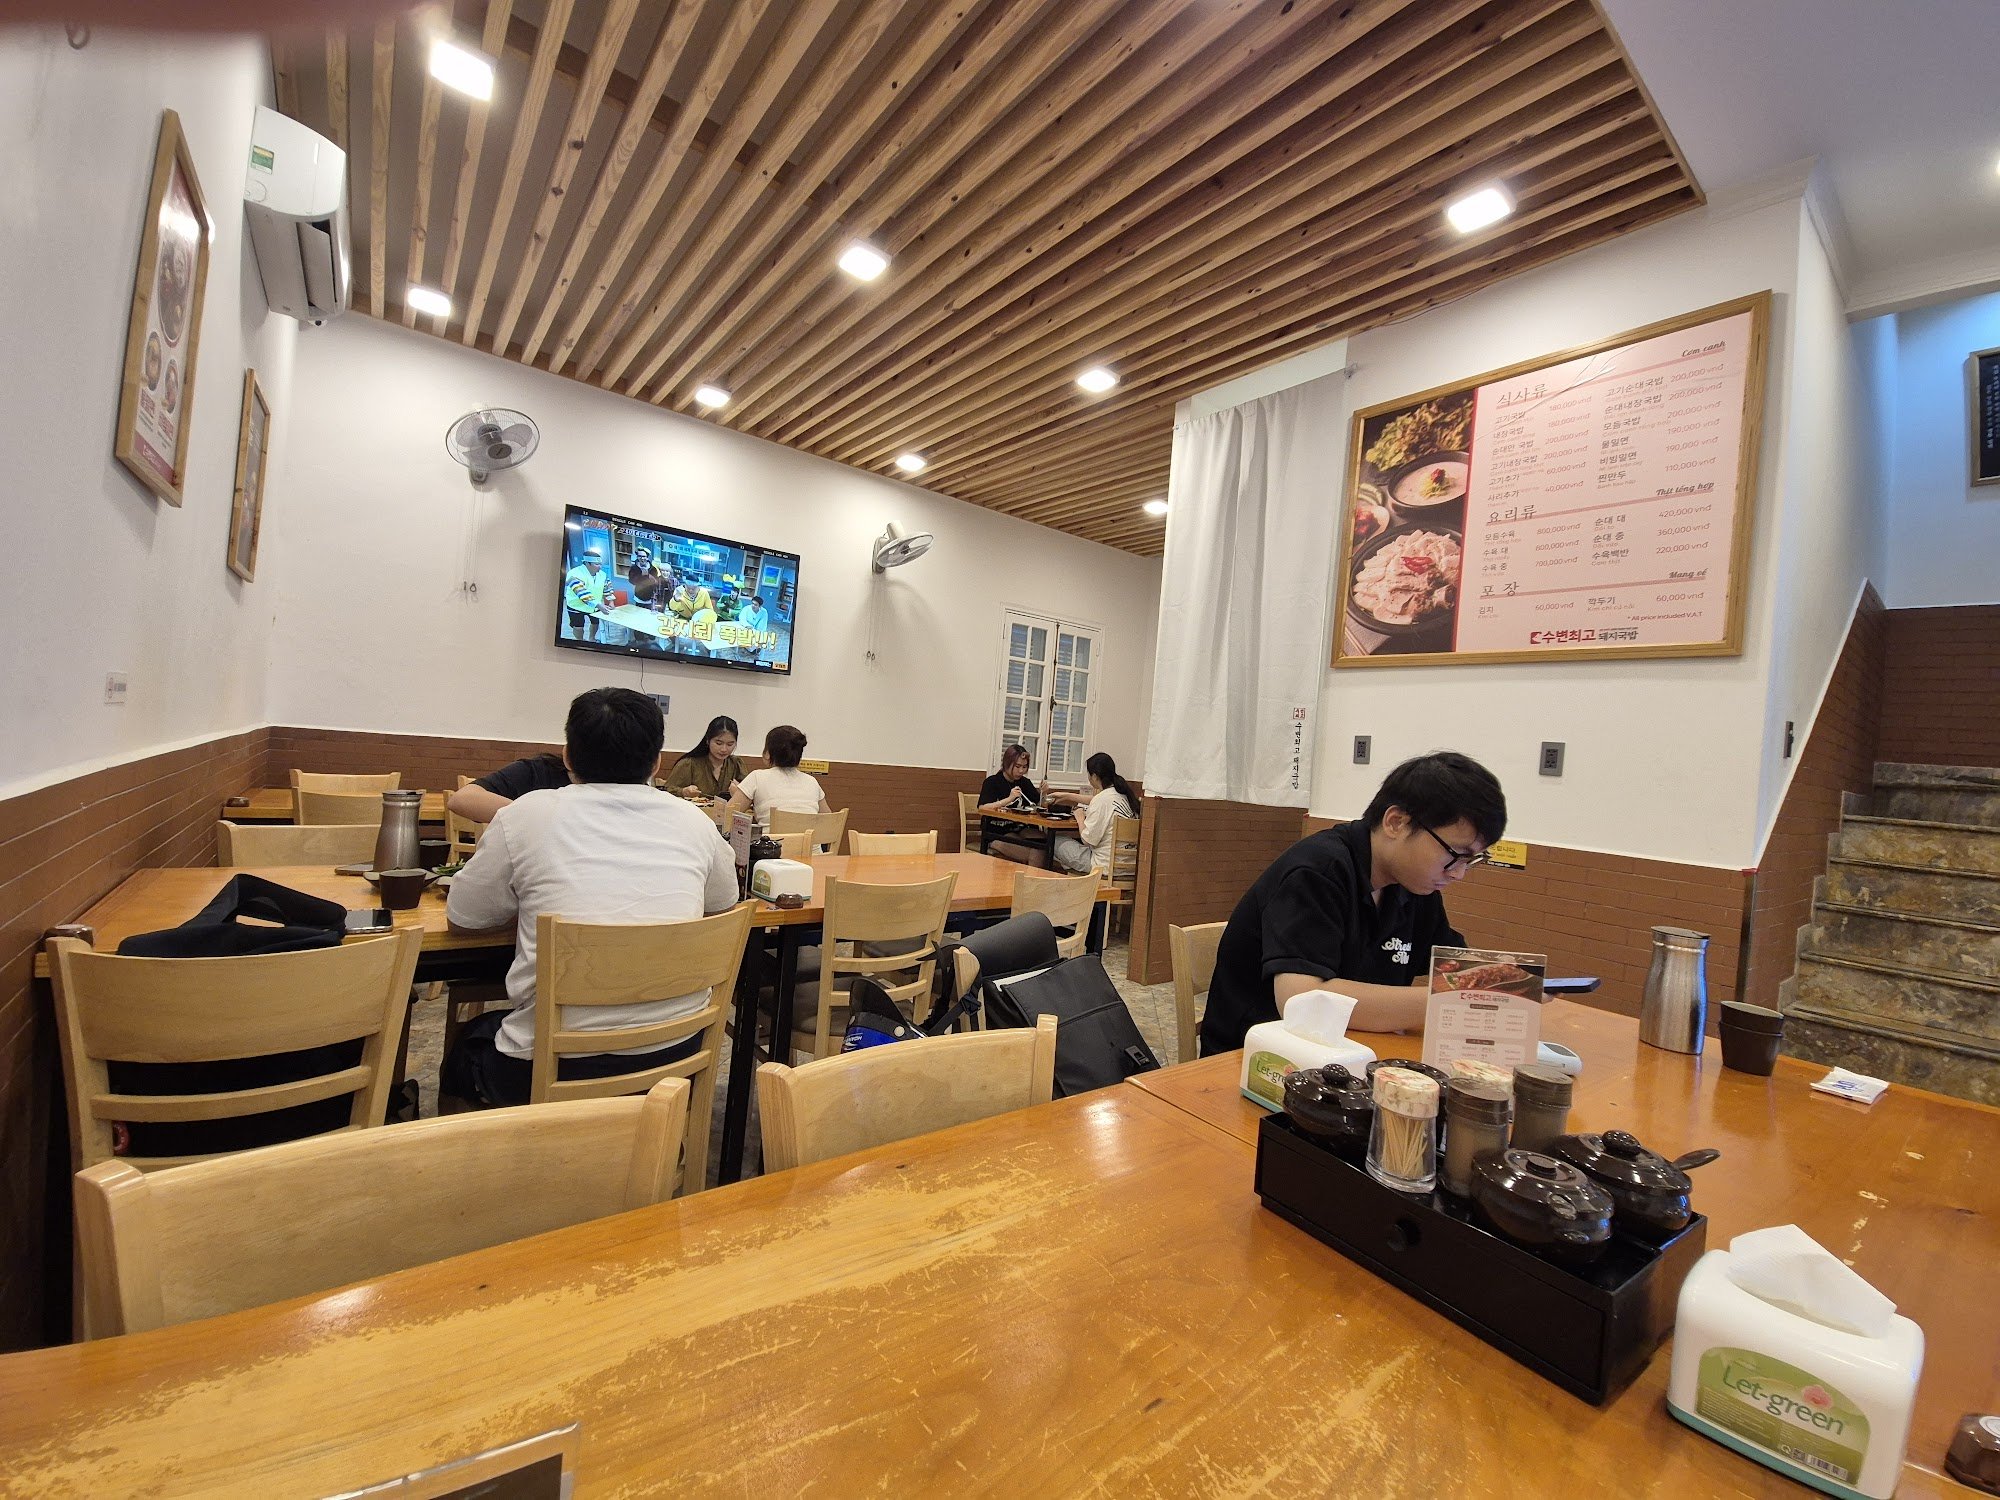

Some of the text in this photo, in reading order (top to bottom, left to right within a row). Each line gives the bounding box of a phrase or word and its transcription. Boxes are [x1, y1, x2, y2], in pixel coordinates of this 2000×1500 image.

[1704, 340, 1725, 351] canh
[1606, 378, 1664, 397] 고기순대국밥
[1497, 383, 1548, 408] 식사류
[1605, 396, 1662, 414] 순대내장국밥
[1544, 449, 1573, 460] 200,000
[1491, 455, 1538, 471] 고기내장국밥
[1489, 474, 1520, 486] 고기추가
[1697, 481, 1714, 491] hợp
[1488, 490, 1520, 502] 사리추가
[1488, 505, 1538, 525] 요리류
[1658, 507, 1693, 518] 420,000
[1595, 516, 1613, 526] 순대
[1657, 526, 1692, 537] 360,000
[1593, 533, 1612, 543] 순대
[1656, 543, 1690, 554] 220,000
[1669, 569, 1695, 580] Mang
[1656, 593, 1686, 602] 60,000
[1542, 629, 1639, 644] 수변최고 돼지국밥
[1722, 1364, 1845, 1437] Let-green
